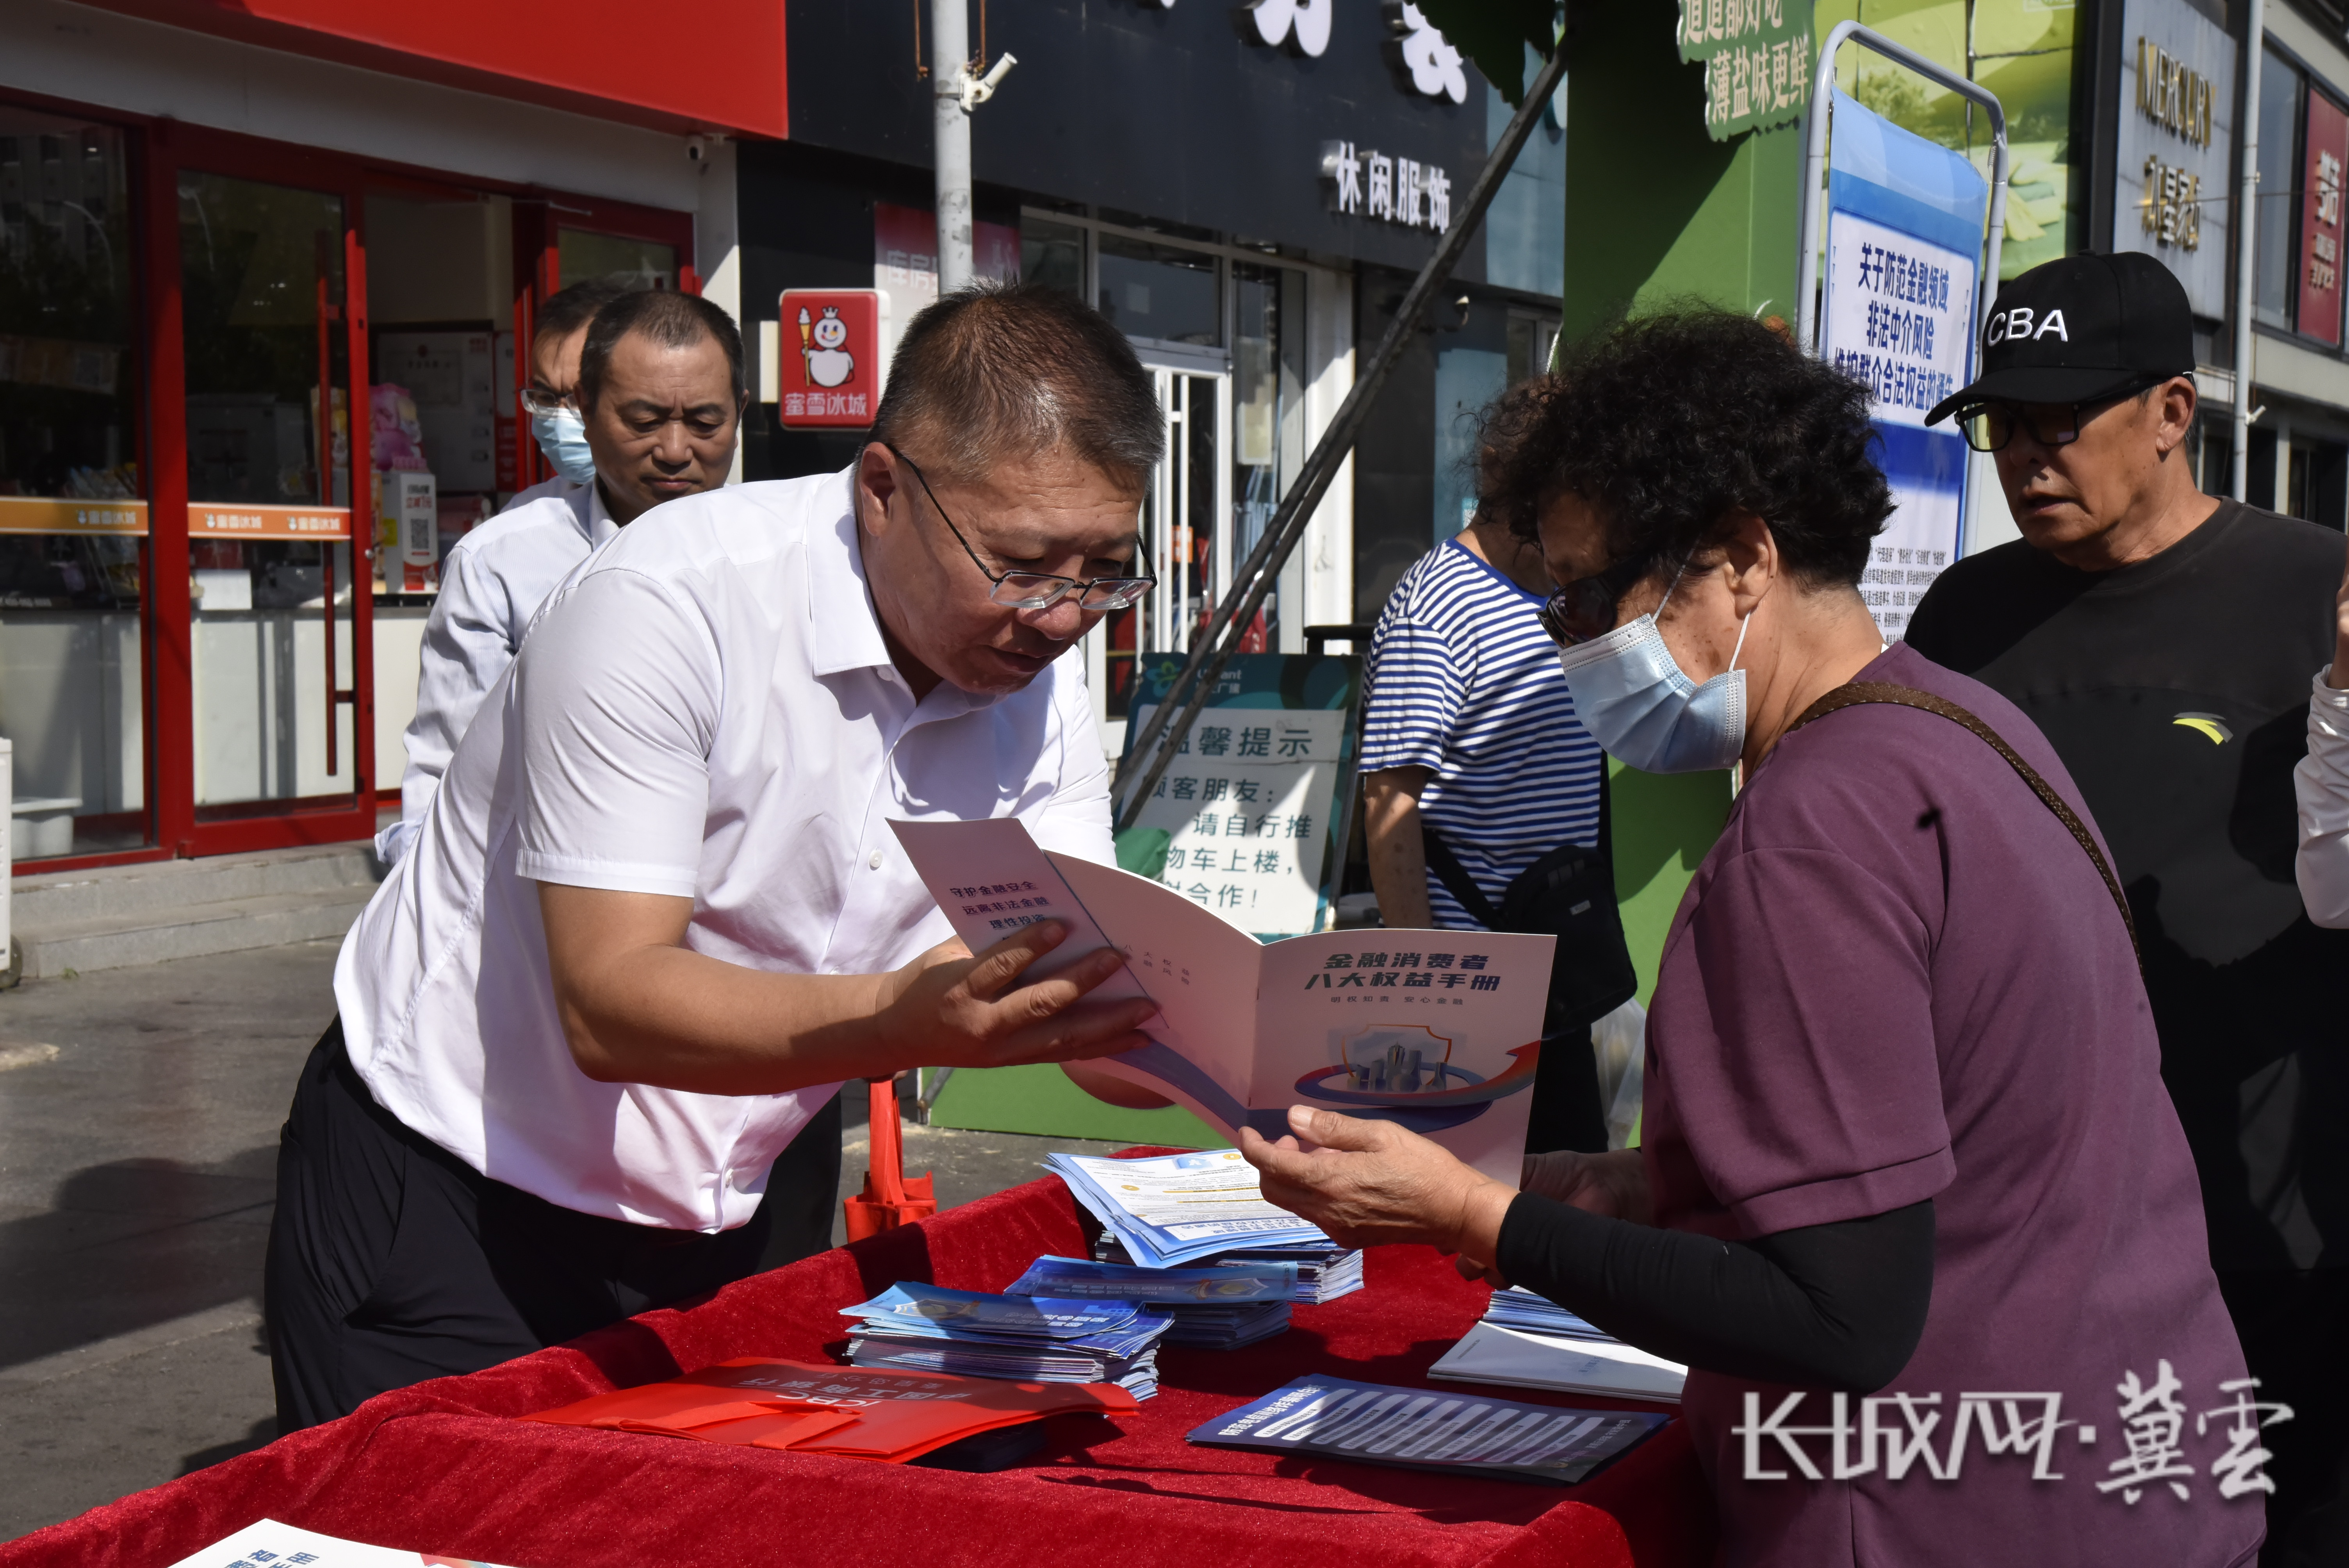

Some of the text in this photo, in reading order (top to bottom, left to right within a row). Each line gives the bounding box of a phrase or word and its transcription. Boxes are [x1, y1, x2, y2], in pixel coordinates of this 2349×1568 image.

[1712, 34, 1809, 125] 薄盐味更鲜
[1336, 141, 1451, 234] 休闲服饰
[1858, 242, 1949, 314] 关于防范金融领域
[1866, 299, 1934, 360] 非法中介风险
[1987, 308, 2068, 346] CBA
[784, 392, 867, 417] 蜜雪冰城
[1193, 812, 1312, 839] 请自行推
[950, 881, 1037, 898] 守护金融安全
[963, 896, 1051, 915] 远离非法金融
[1324, 952, 1490, 970] 金融消费者
[1304, 971, 1501, 991] 八大权益手册
[739, 1378, 972, 1400] 中国工商银行
[815, 1373, 944, 1389] 秦皇岛分行
[775, 1391, 882, 1407] ICBC
